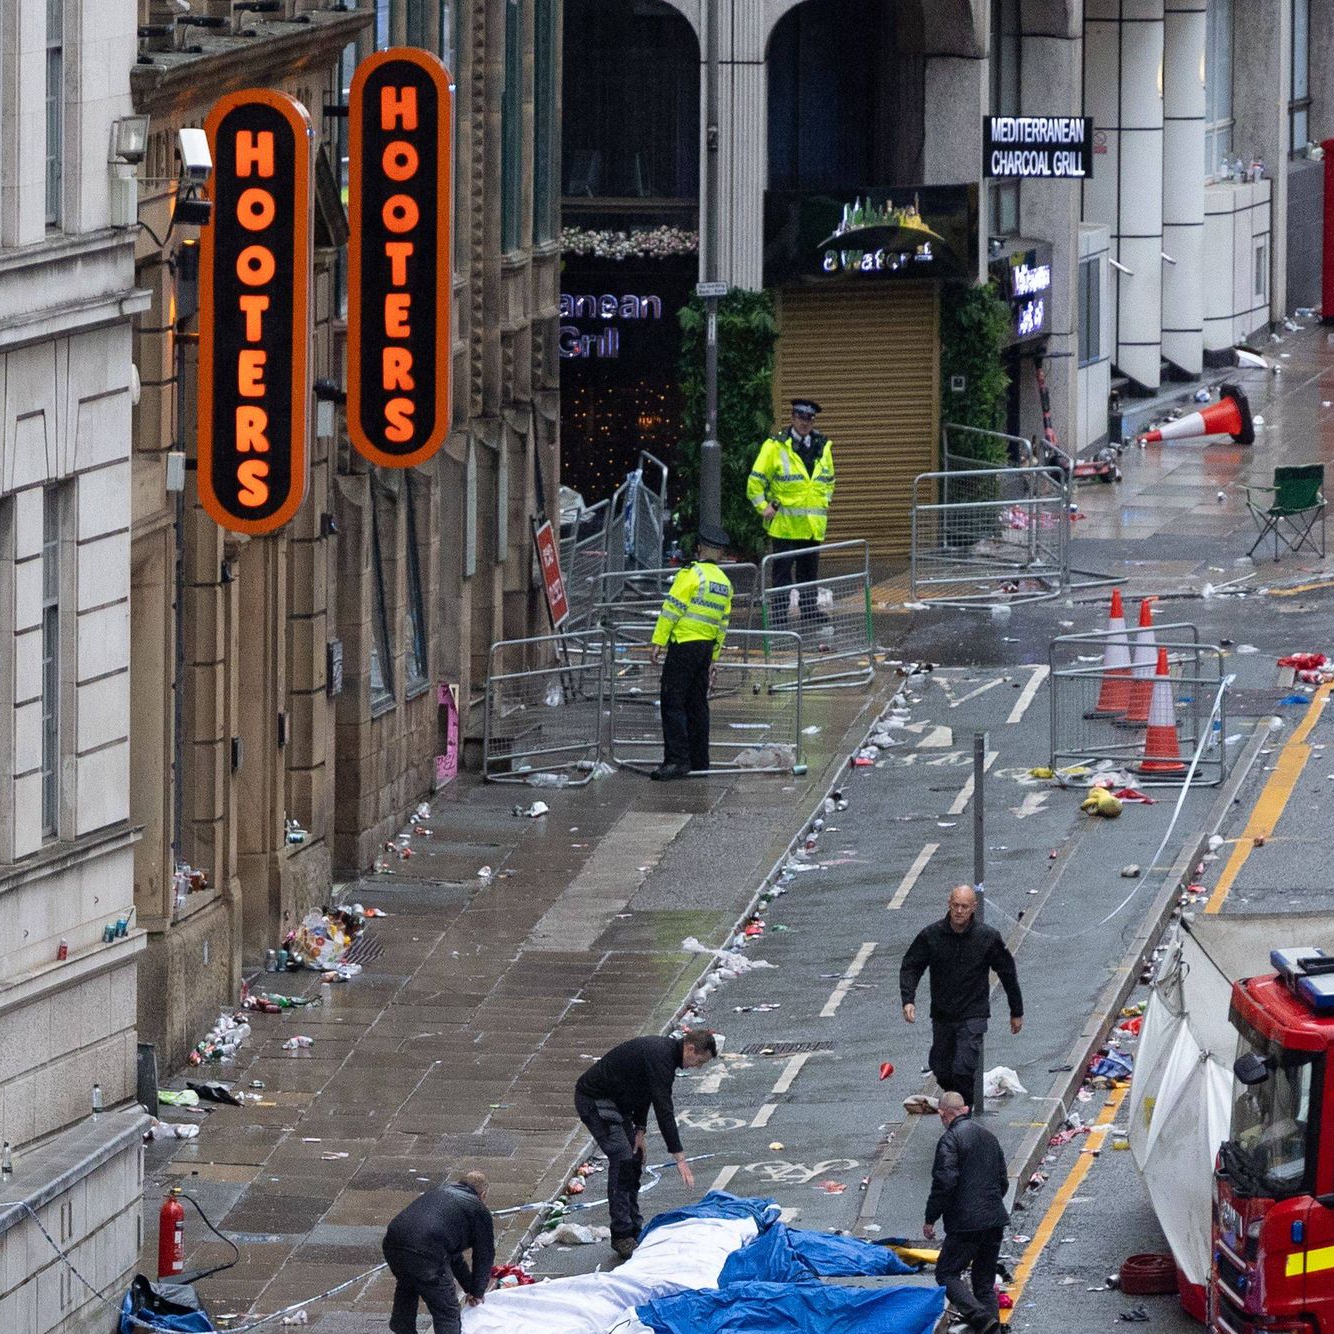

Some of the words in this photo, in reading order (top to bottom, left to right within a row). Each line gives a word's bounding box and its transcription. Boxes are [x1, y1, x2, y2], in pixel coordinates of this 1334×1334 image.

[991, 118, 1085, 143] MEDITERRANEAN
[991, 151, 1051, 176] CHARCOAL
[1053, 151, 1086, 176] GRILL
[235, 130, 276, 507] HOOTERS
[381, 86, 420, 443] HOOTERS
